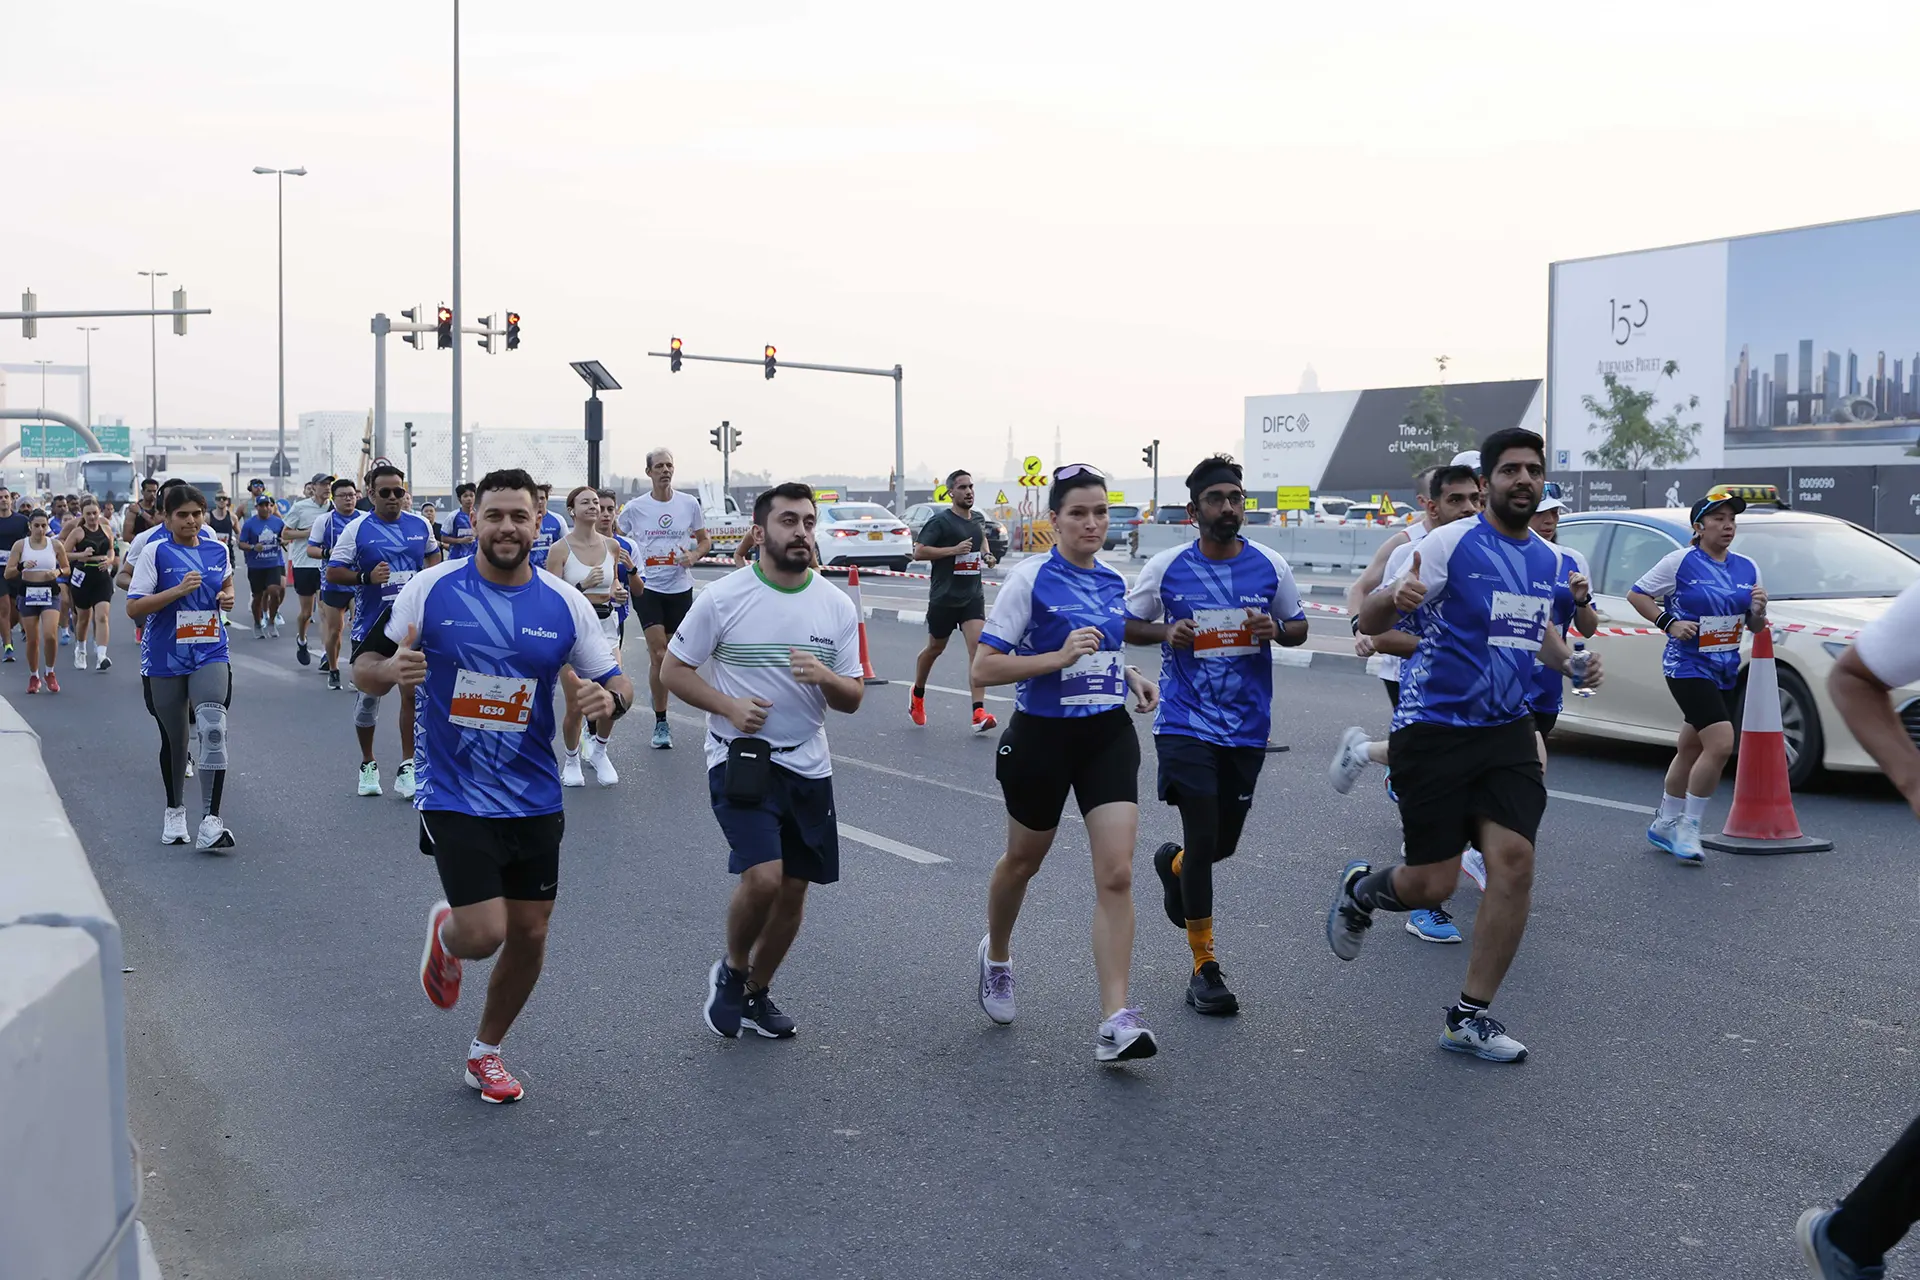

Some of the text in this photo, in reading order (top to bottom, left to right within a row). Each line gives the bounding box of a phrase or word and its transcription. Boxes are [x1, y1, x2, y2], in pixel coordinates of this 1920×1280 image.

[1636, 357, 1660, 372] PIGUET
[1263, 415, 1295, 433] DIFC
[1398, 423, 1417, 436] The
[1262, 440, 1315, 451] Developments
[1388, 440, 1399, 453] of
[1400, 440, 1429, 453] Urban
[1589, 481, 1612, 492] Building
[1798, 478, 1835, 489] 8009090
[1799, 492, 1822, 501] rta.ae
[522, 627, 558, 639] Plus500
[469, 692, 483, 700] KM
[478, 704, 506, 716] 1630
